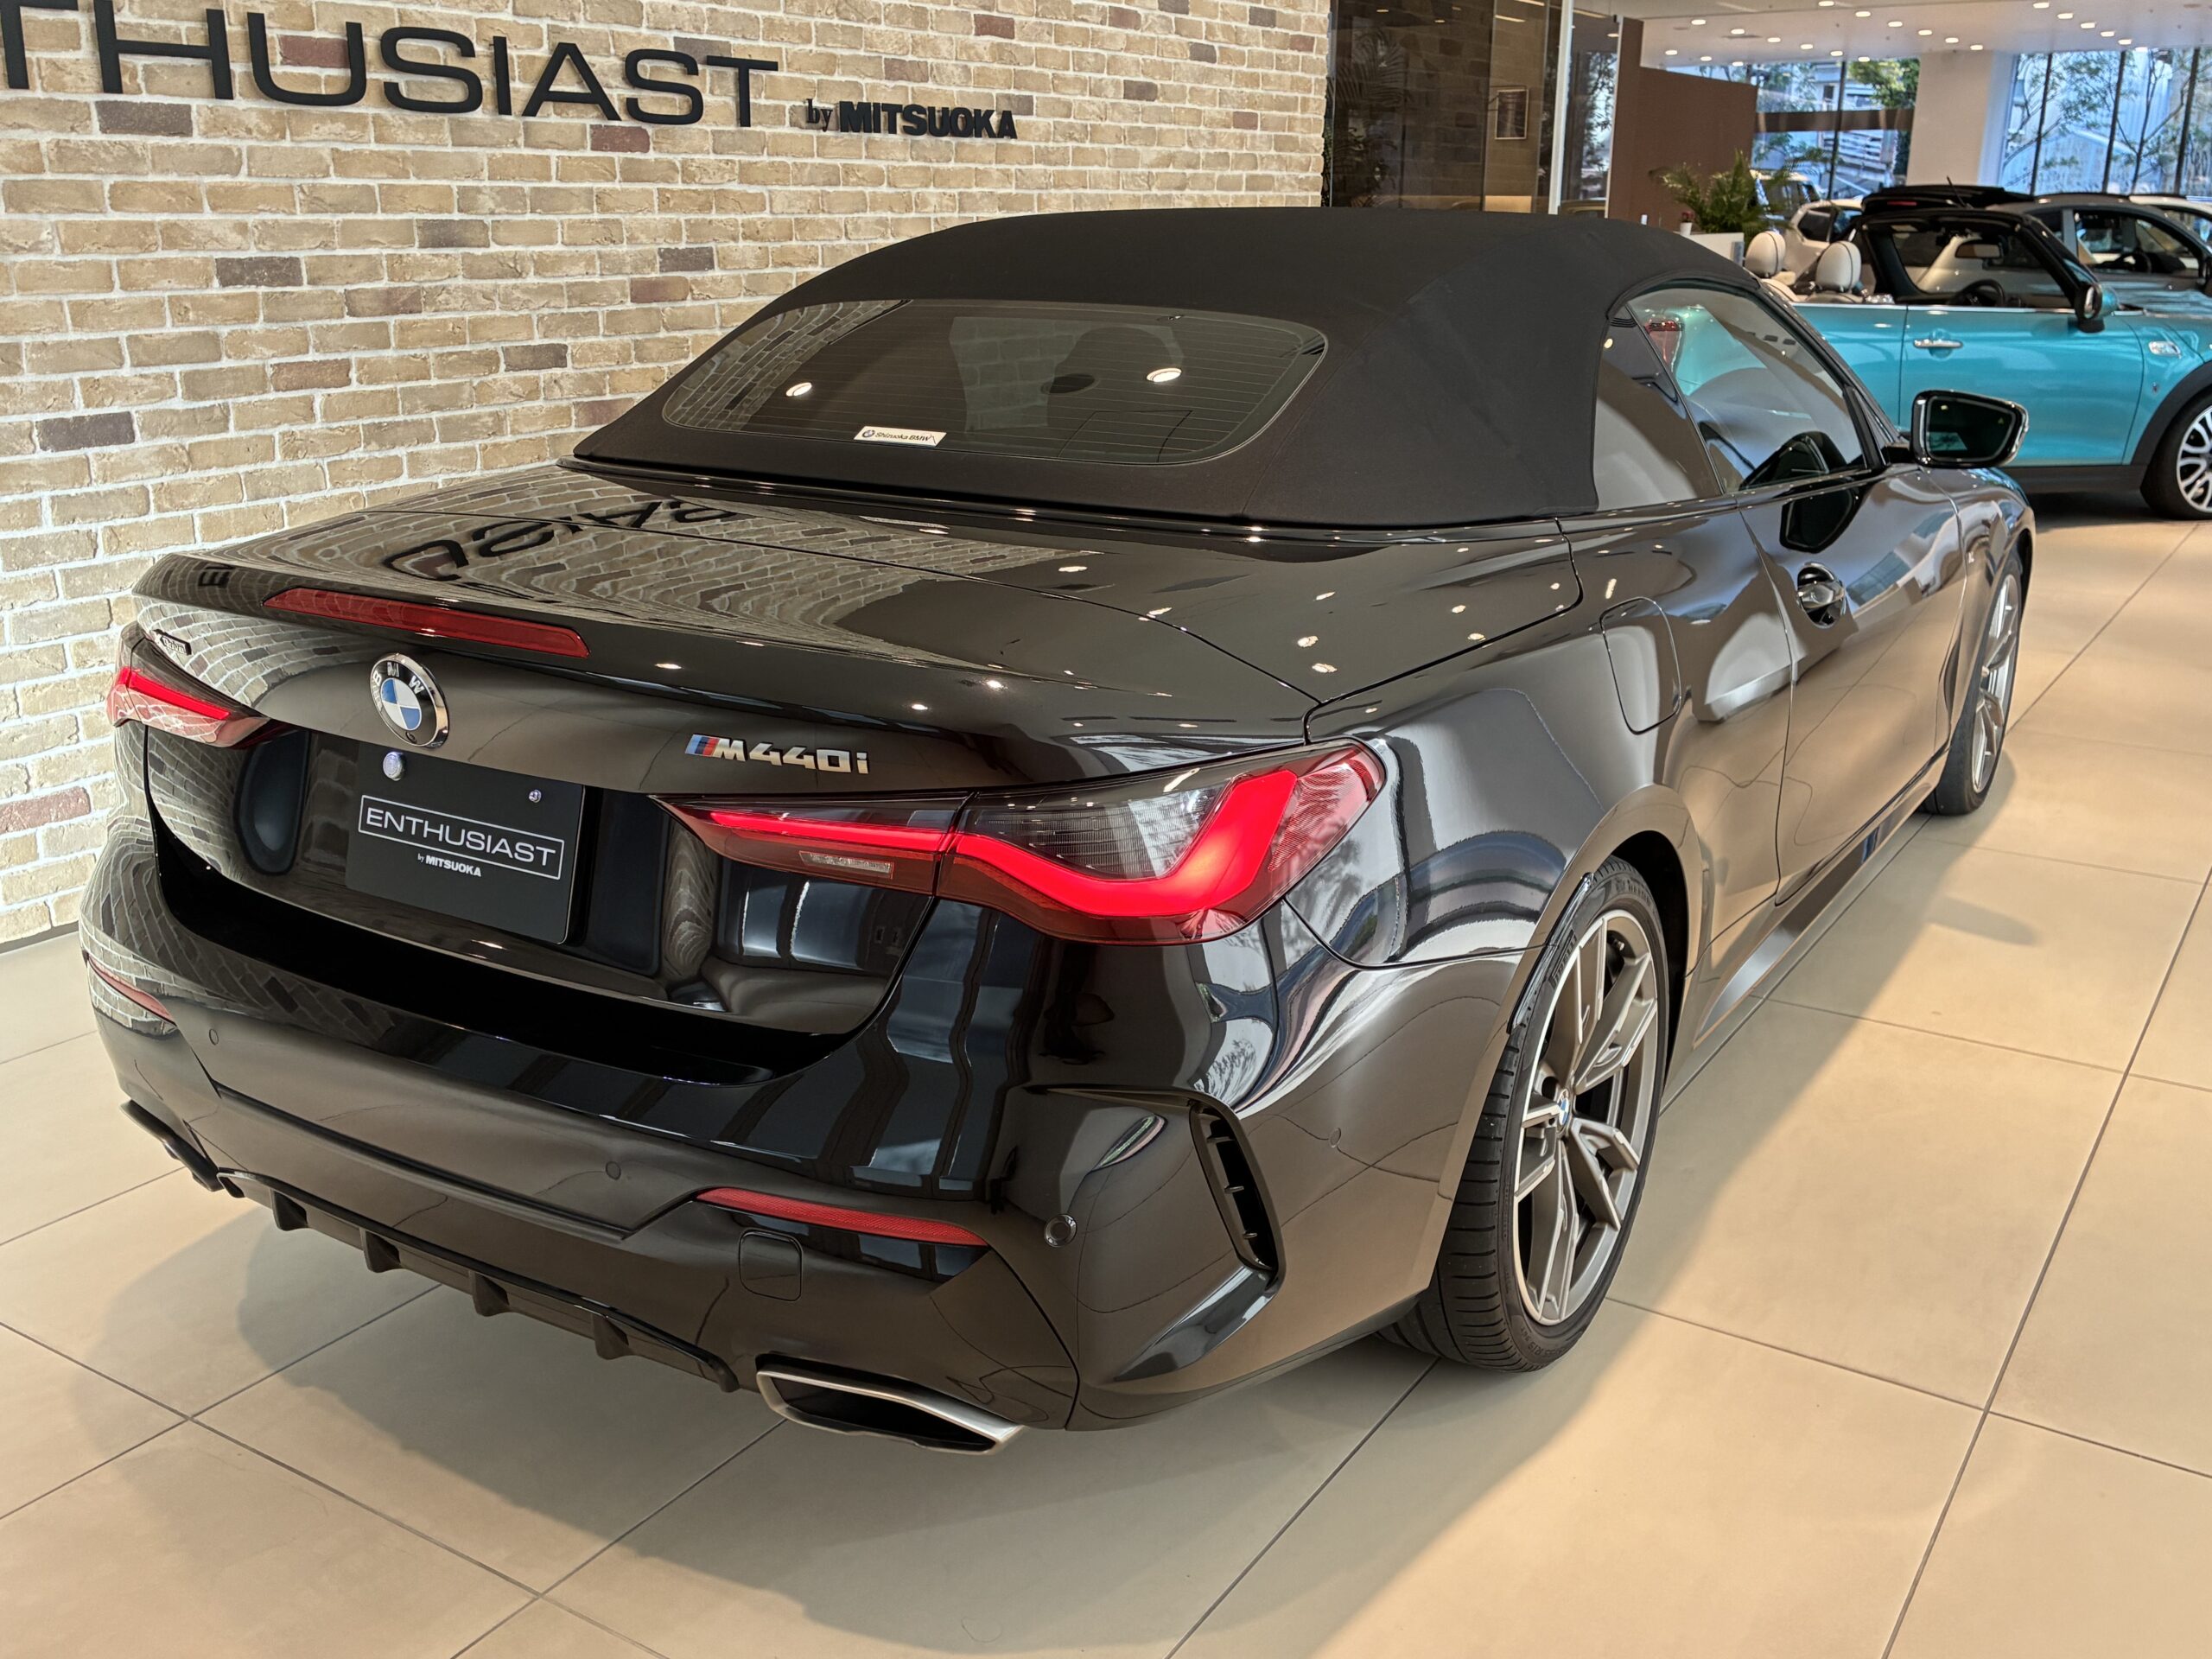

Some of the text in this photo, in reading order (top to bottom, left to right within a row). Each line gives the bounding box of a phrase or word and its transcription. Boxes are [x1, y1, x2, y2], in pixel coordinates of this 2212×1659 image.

[806, 99, 1018, 139] by MITSUOKA
[875, 432, 908, 441] Shizuoka
[712, 738, 869, 774] M440i
[365, 806, 556, 867] ENTHUSIAST
[417, 852, 481, 878] by MITSUOKA
